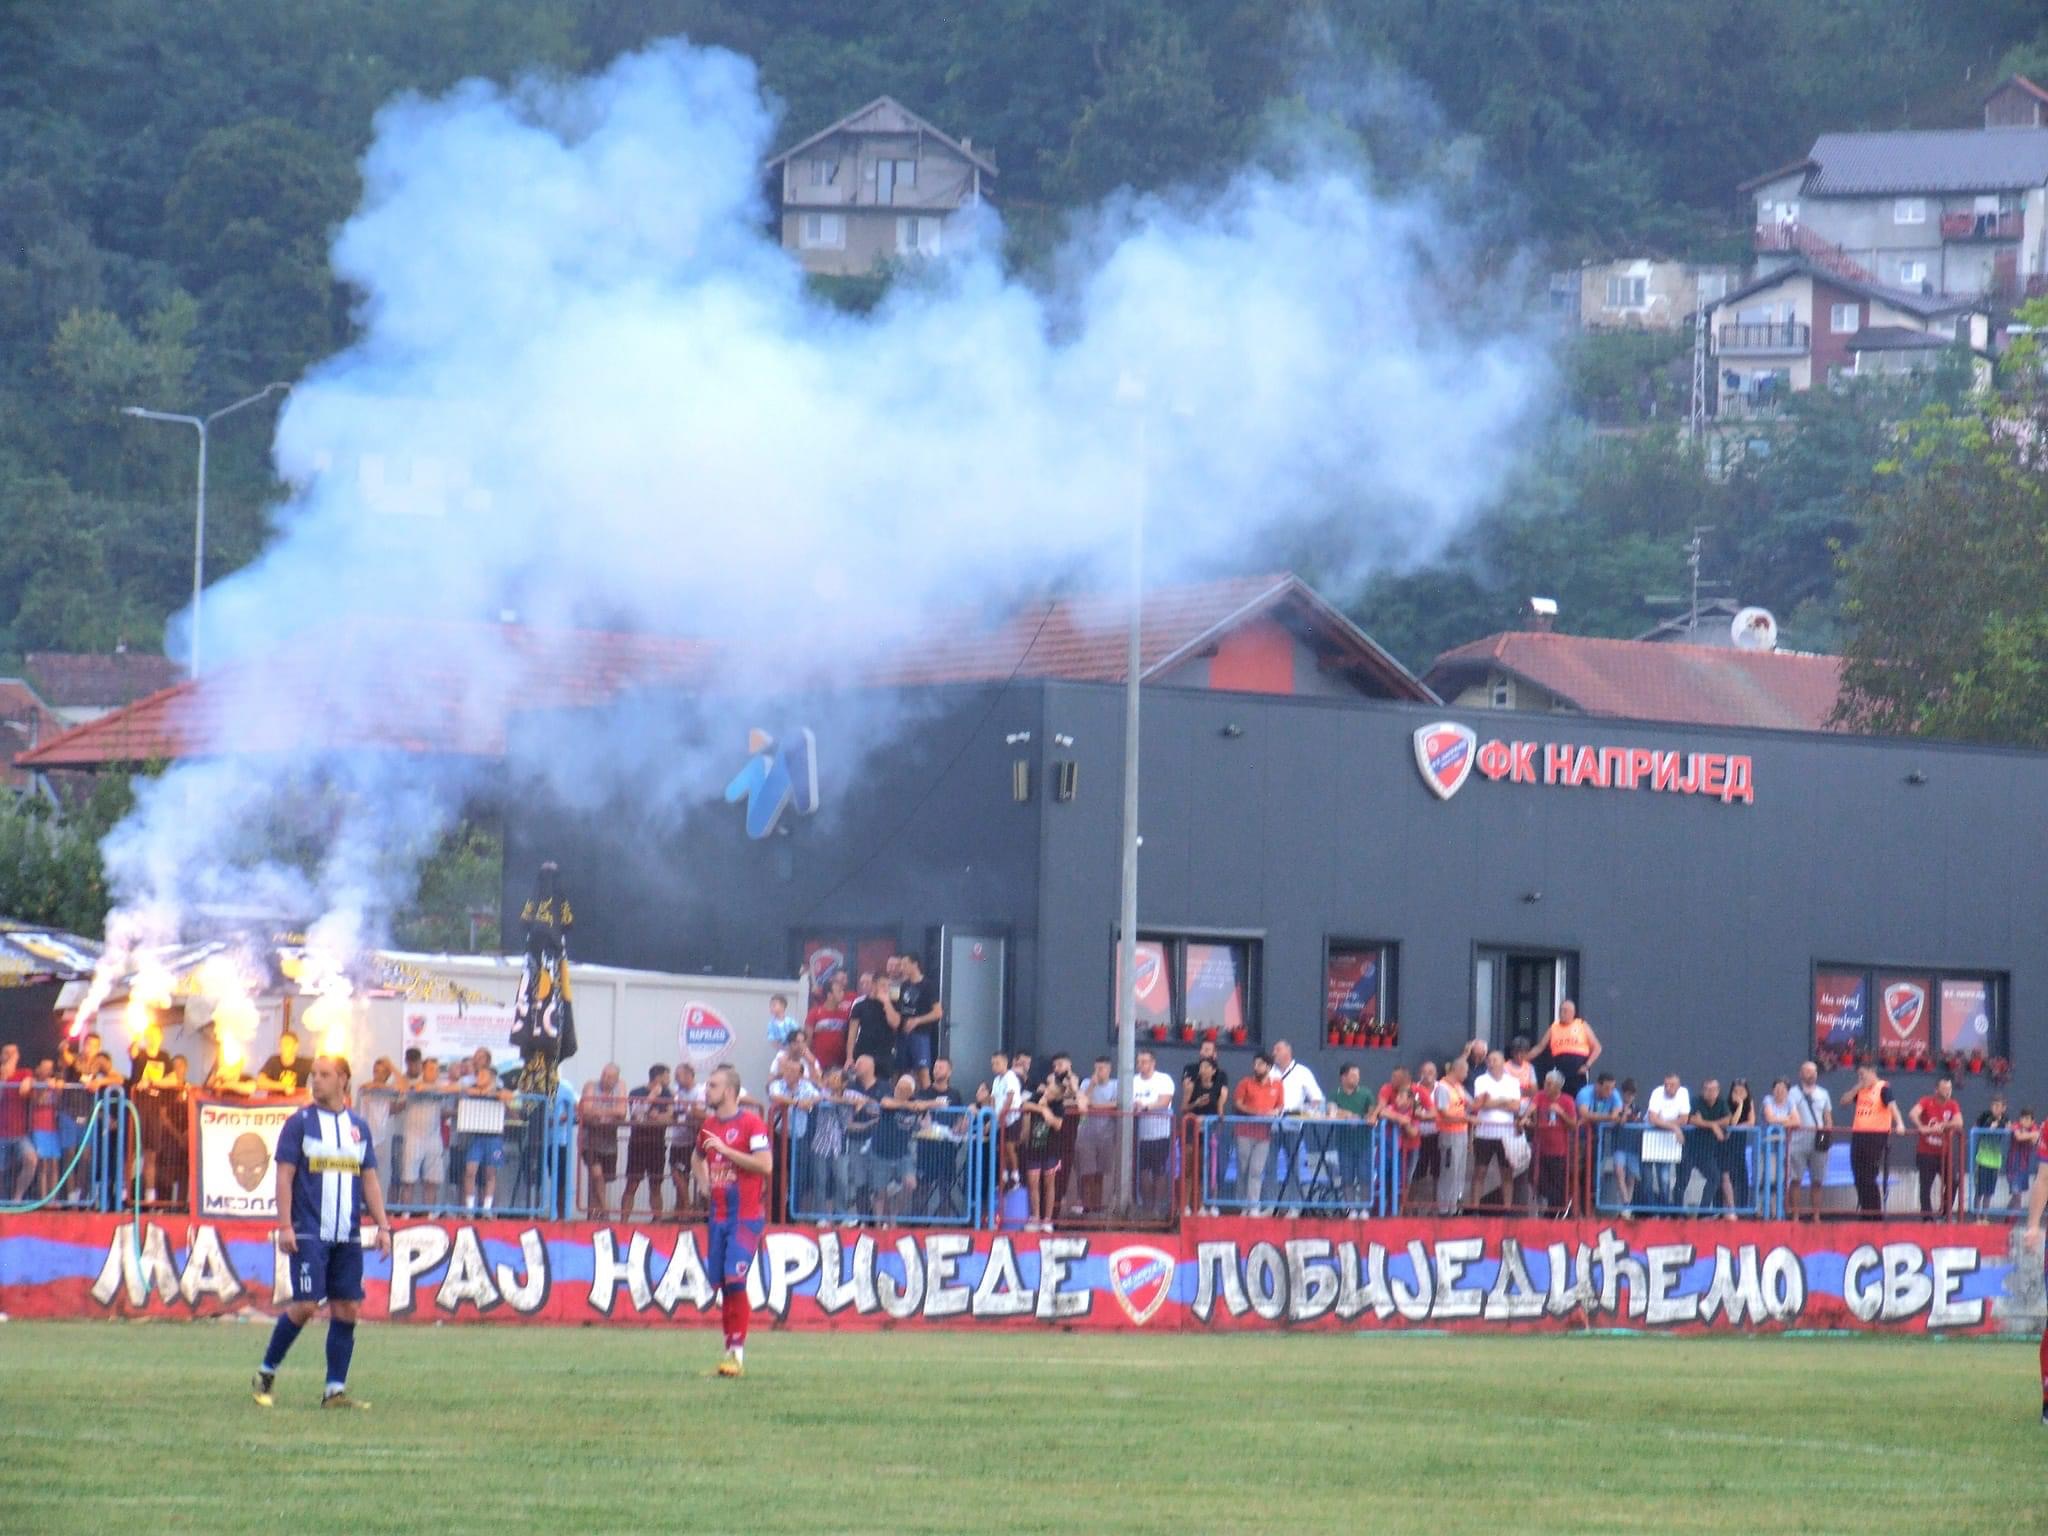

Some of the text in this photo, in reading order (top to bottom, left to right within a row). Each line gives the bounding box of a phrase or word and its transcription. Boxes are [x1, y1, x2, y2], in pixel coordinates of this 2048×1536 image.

[1476, 739, 1538, 784] ФК
[1544, 743, 1754, 804] НАПРИЈЕД
[91, 1221, 245, 1306] МА
[1191, 1227, 1804, 1324] ПОБИЈЕДИЋЕМО
[1843, 1242, 1985, 1328] СВЕ
